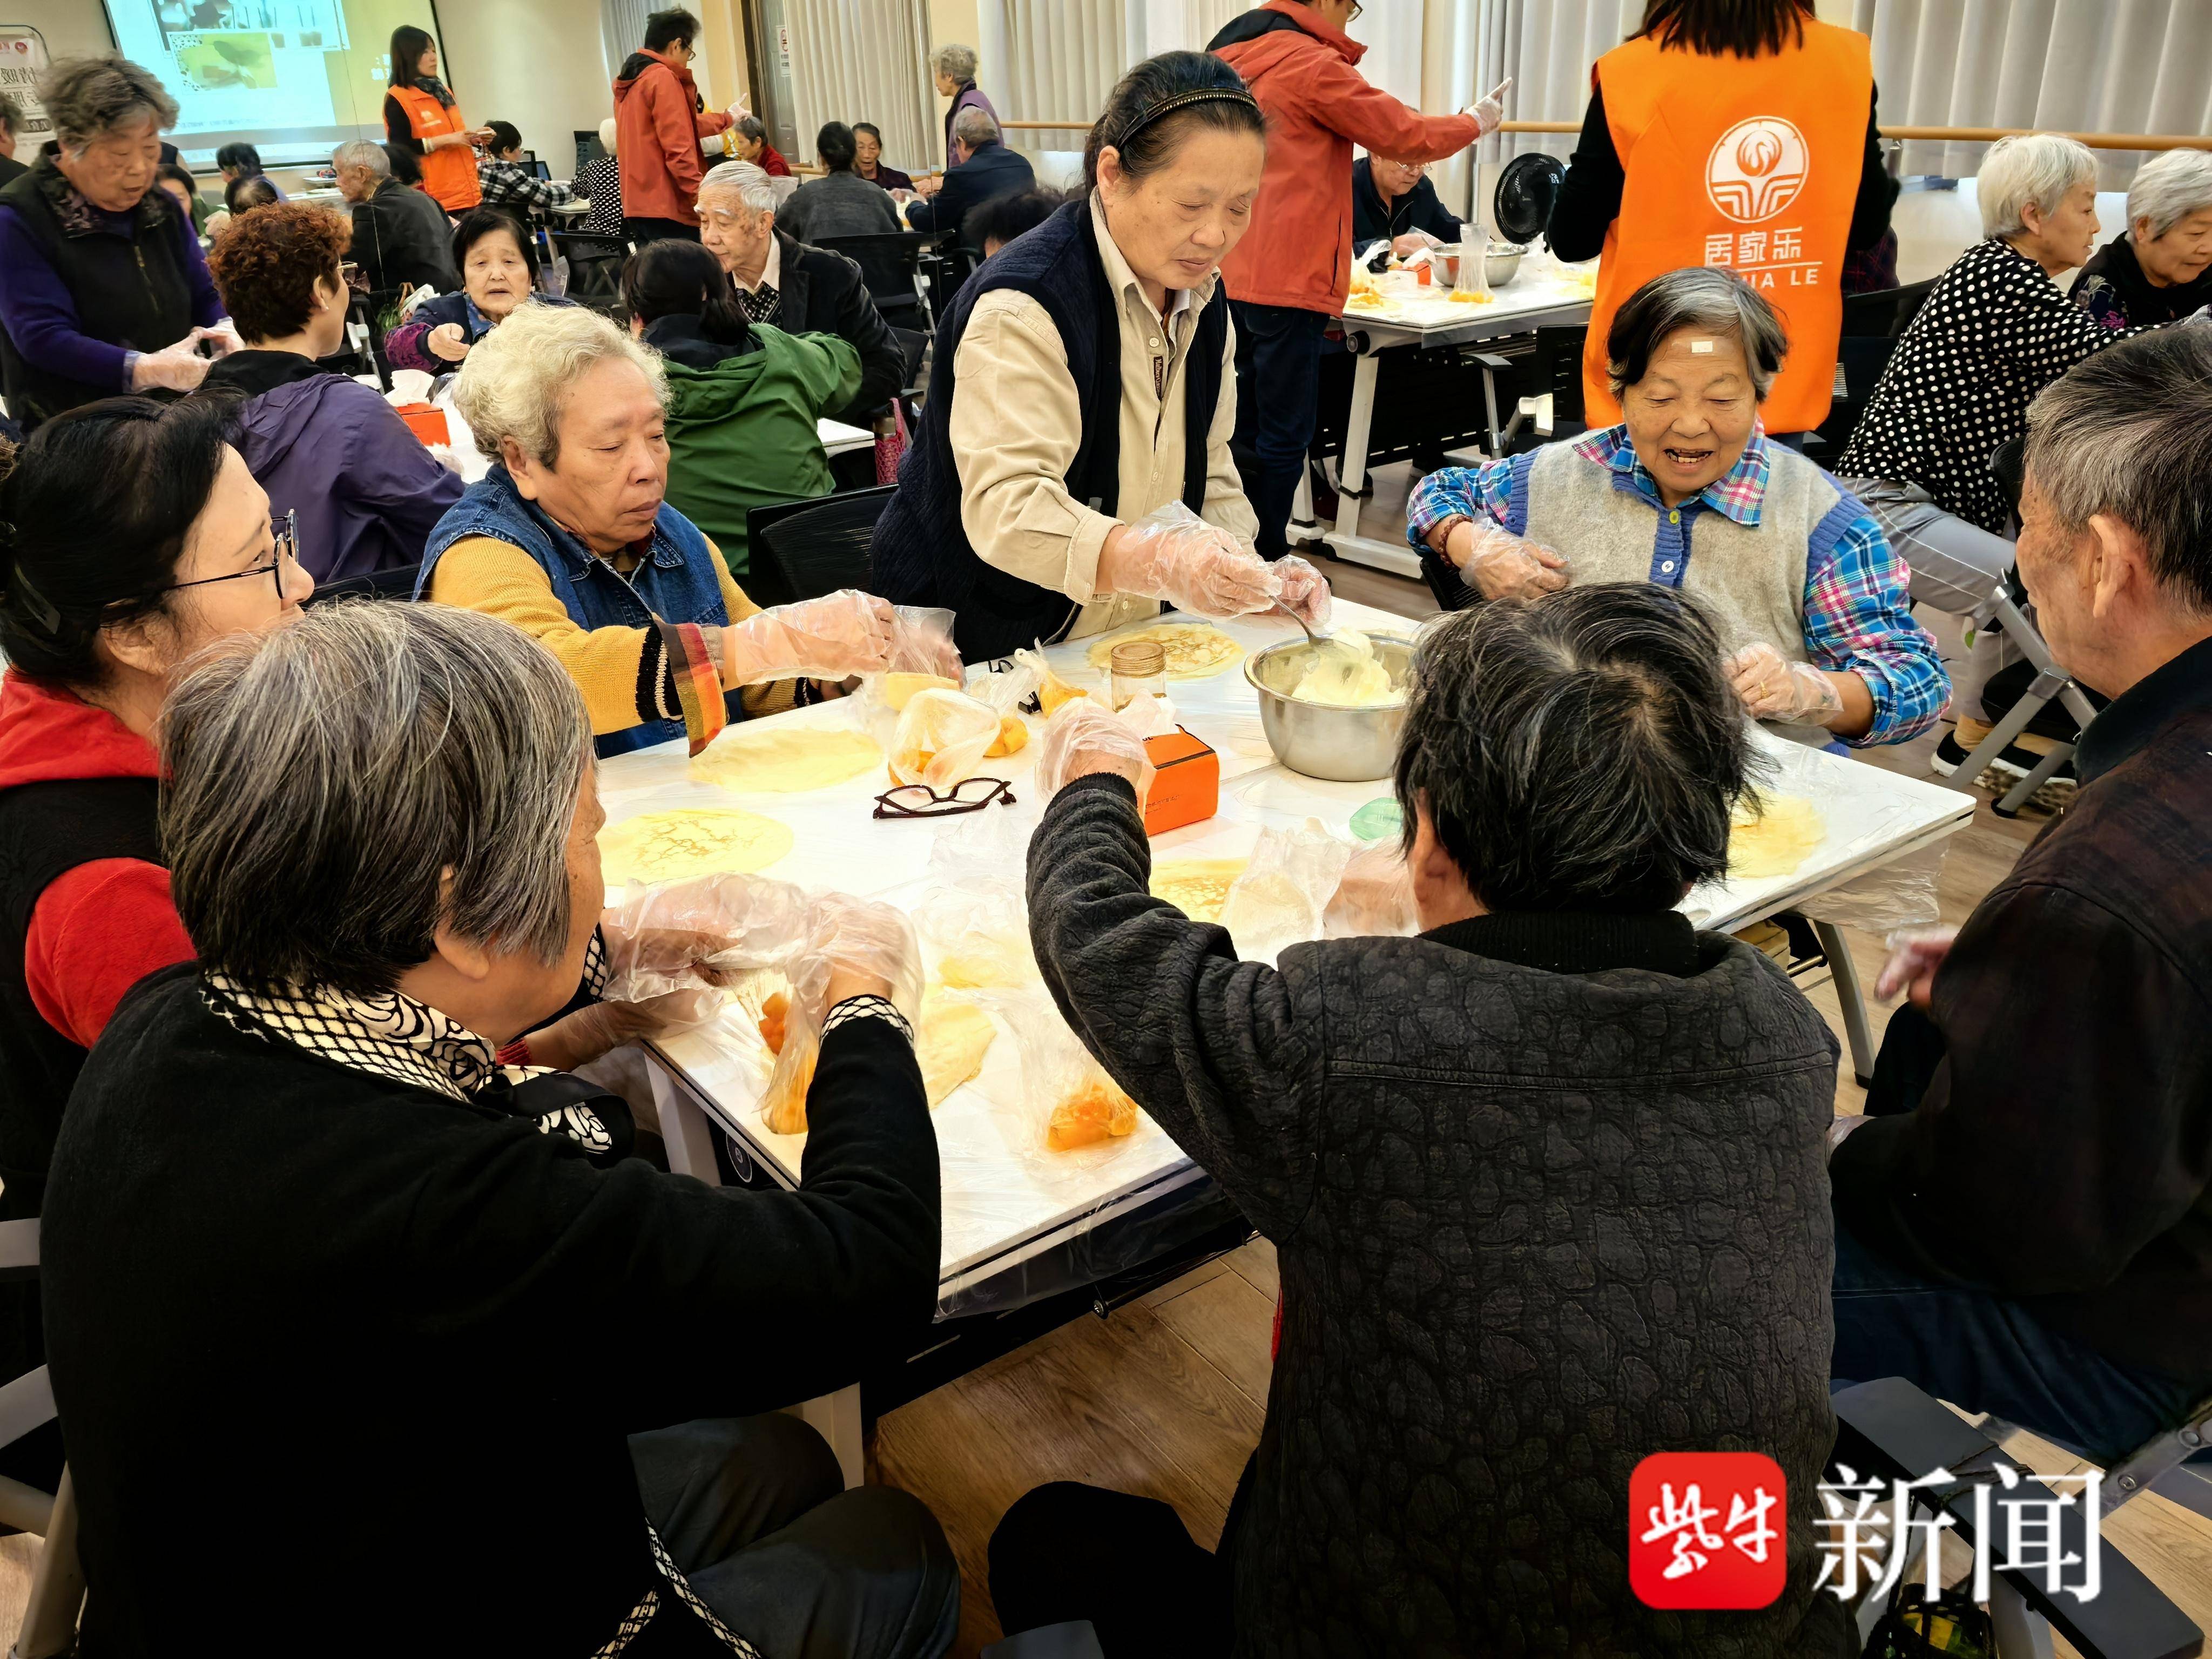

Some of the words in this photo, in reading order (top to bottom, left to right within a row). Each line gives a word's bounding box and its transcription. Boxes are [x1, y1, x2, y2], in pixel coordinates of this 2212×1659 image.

[1705, 226, 1803, 266] 居家乐
[1790, 268, 1818, 286] LE
